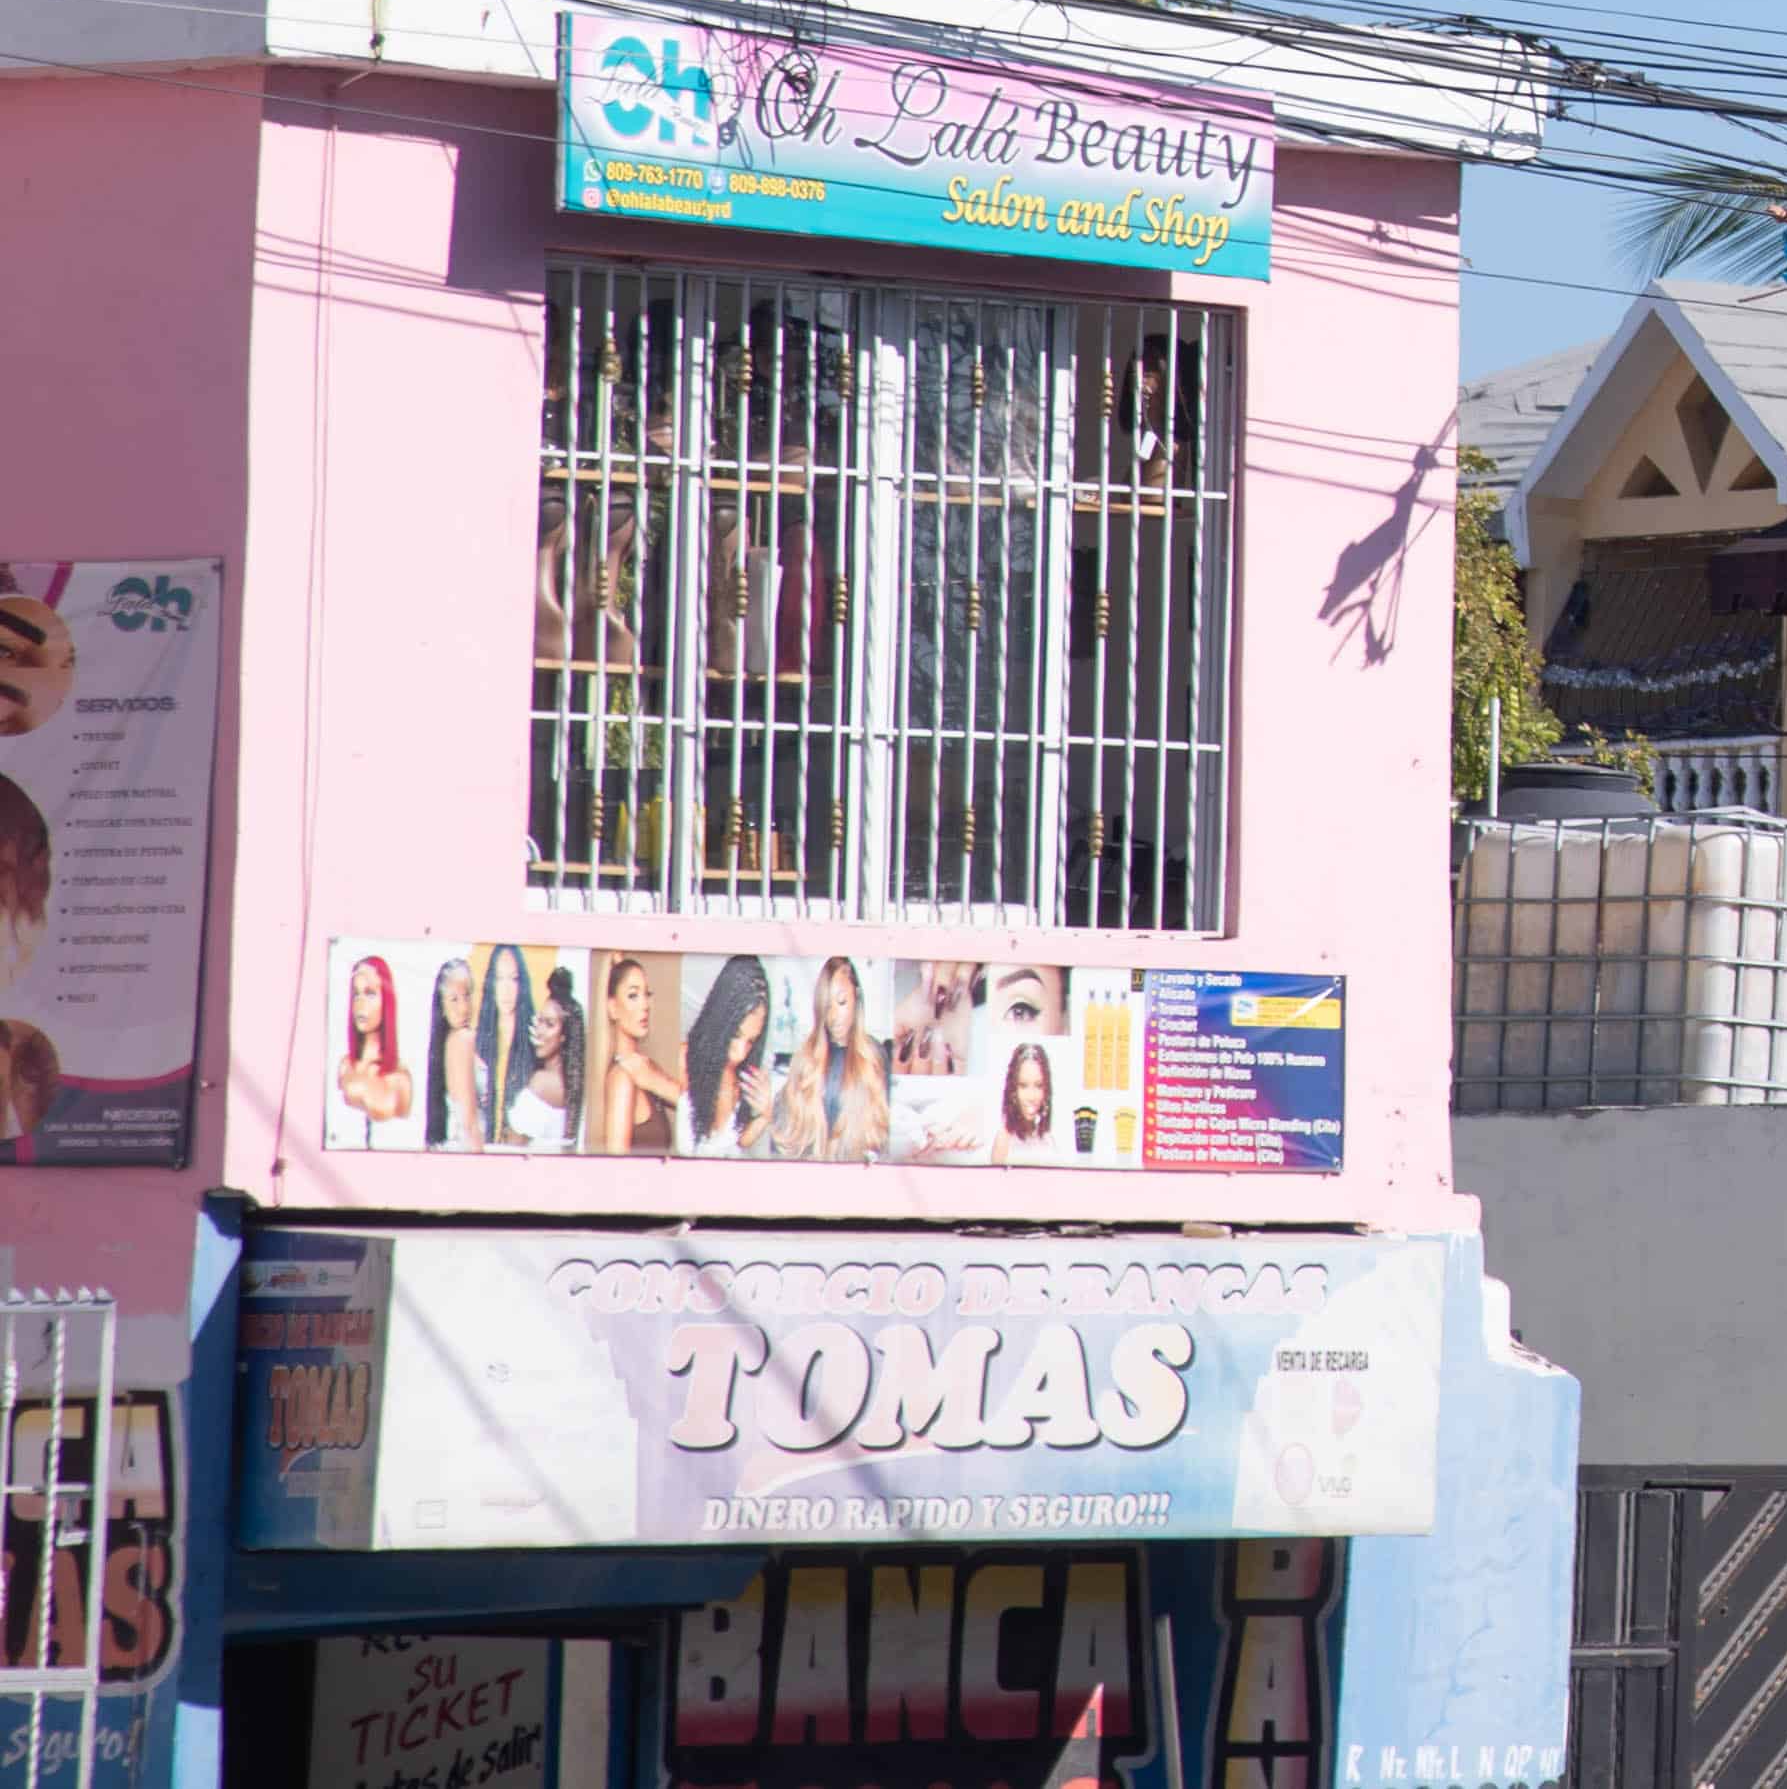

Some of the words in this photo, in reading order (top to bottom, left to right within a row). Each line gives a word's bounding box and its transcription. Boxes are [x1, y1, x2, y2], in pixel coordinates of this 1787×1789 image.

[606, 161, 704, 189] 809-763-1770
[756, 58, 842, 145] Oh
[1034, 99, 1257, 208] Beauty
[942, 175, 1047, 231] Salon
[1056, 188, 1141, 241] and
[1139, 194, 1230, 266] Shop
[547, 1259, 947, 1315] CONSORCIO
[957, 1263, 1050, 1315] DE
[669, 1322, 1195, 1451] TOMAS
[1276, 1351, 1306, 1371] VENTA
[1309, 1351, 1322, 1371] DE
[1325, 1351, 1369, 1371] RECARGA
[268, 1363, 371, 1450] TOMAS
[703, 1496, 837, 1531] DINERO
[844, 1496, 972, 1531] RAPIDO
[981, 1495, 1006, 1527] Y
[1008, 1493, 1171, 1528] SEGURO!!!
[407, 1652, 458, 1702] SU
[675, 1563, 1133, 1745] BANCA
[350, 1668, 526, 1766] TICKET
